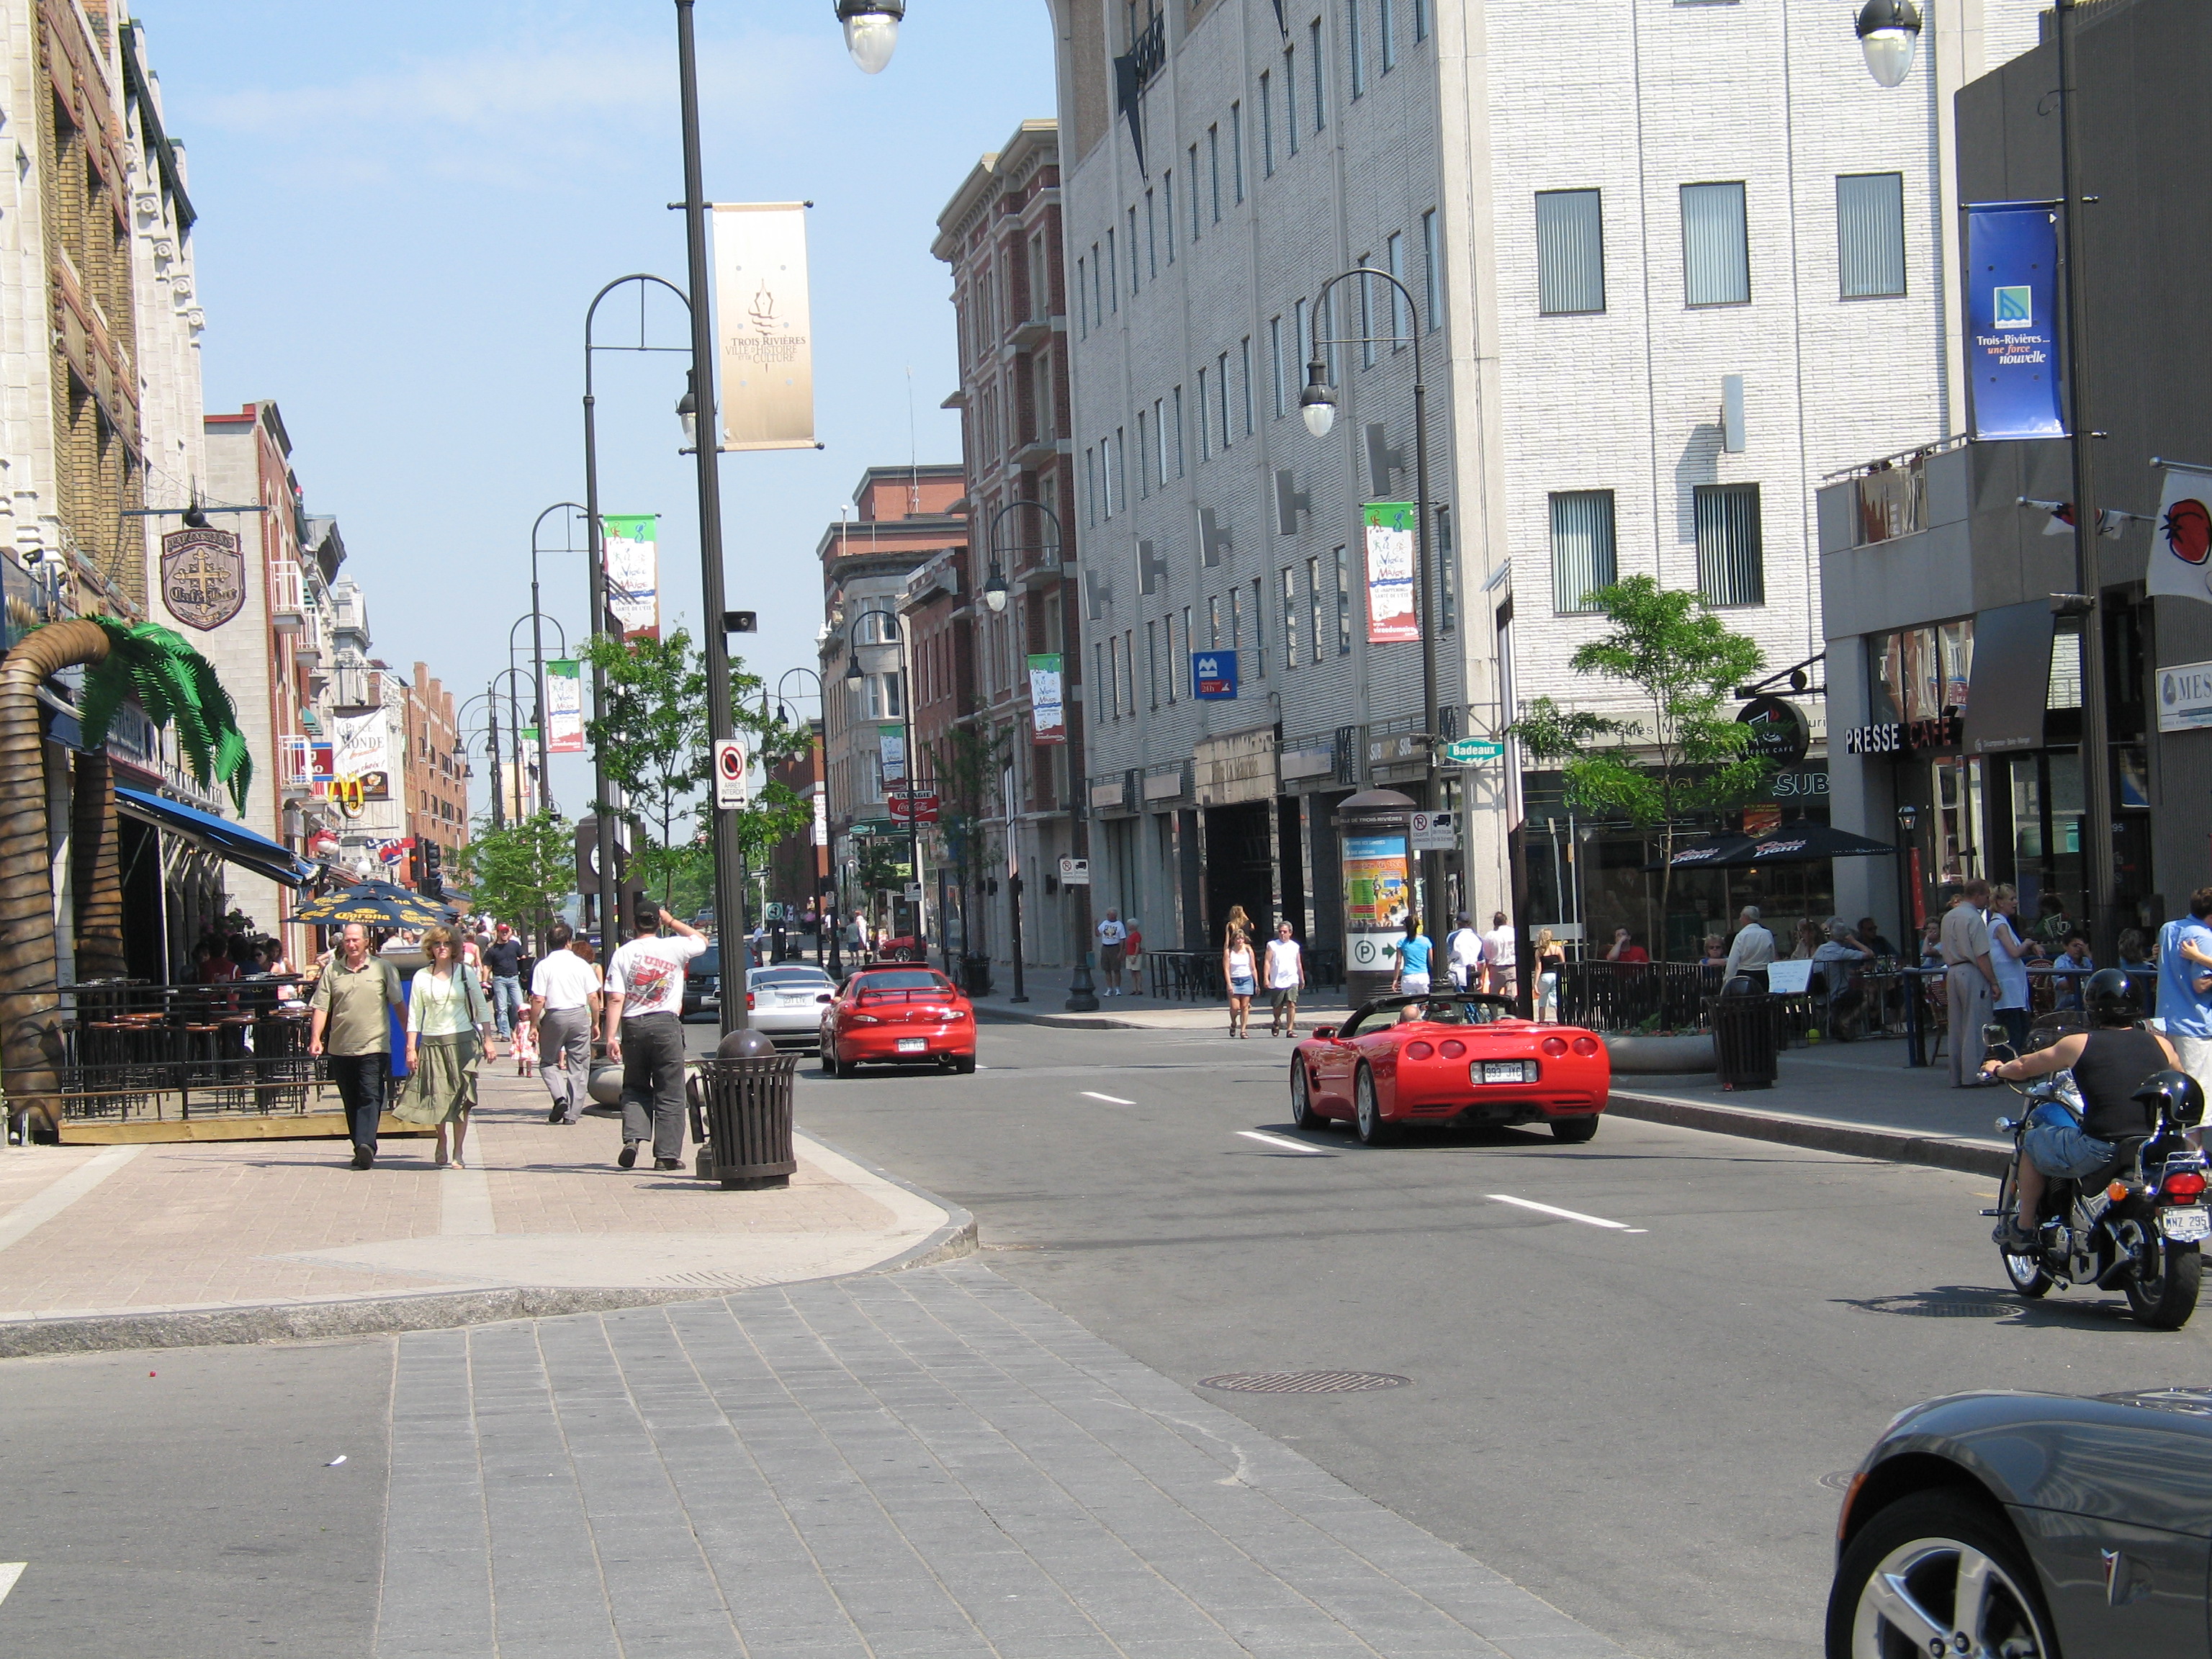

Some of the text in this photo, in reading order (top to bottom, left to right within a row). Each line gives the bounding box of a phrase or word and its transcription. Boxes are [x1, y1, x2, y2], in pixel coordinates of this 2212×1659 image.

[730, 334, 806, 346] TROIS-RIVIÈRES
[725, 346, 750, 356] VILLE
[2005, 345, 2031, 356] force
[752, 353, 795, 364] CULTURE
[1999, 351, 2046, 364] nouvelle
[1845, 723, 1900, 754] PRESSE
[1452, 745, 1496, 756] Badeaux
[367, 838, 380, 848] LE
[1753, 845, 1802, 858] LIGHT
[1670, 853, 1713, 864] LIGHT
[333, 911, 392, 921] Corona
[2189, 1215, 2206, 1227] 295
